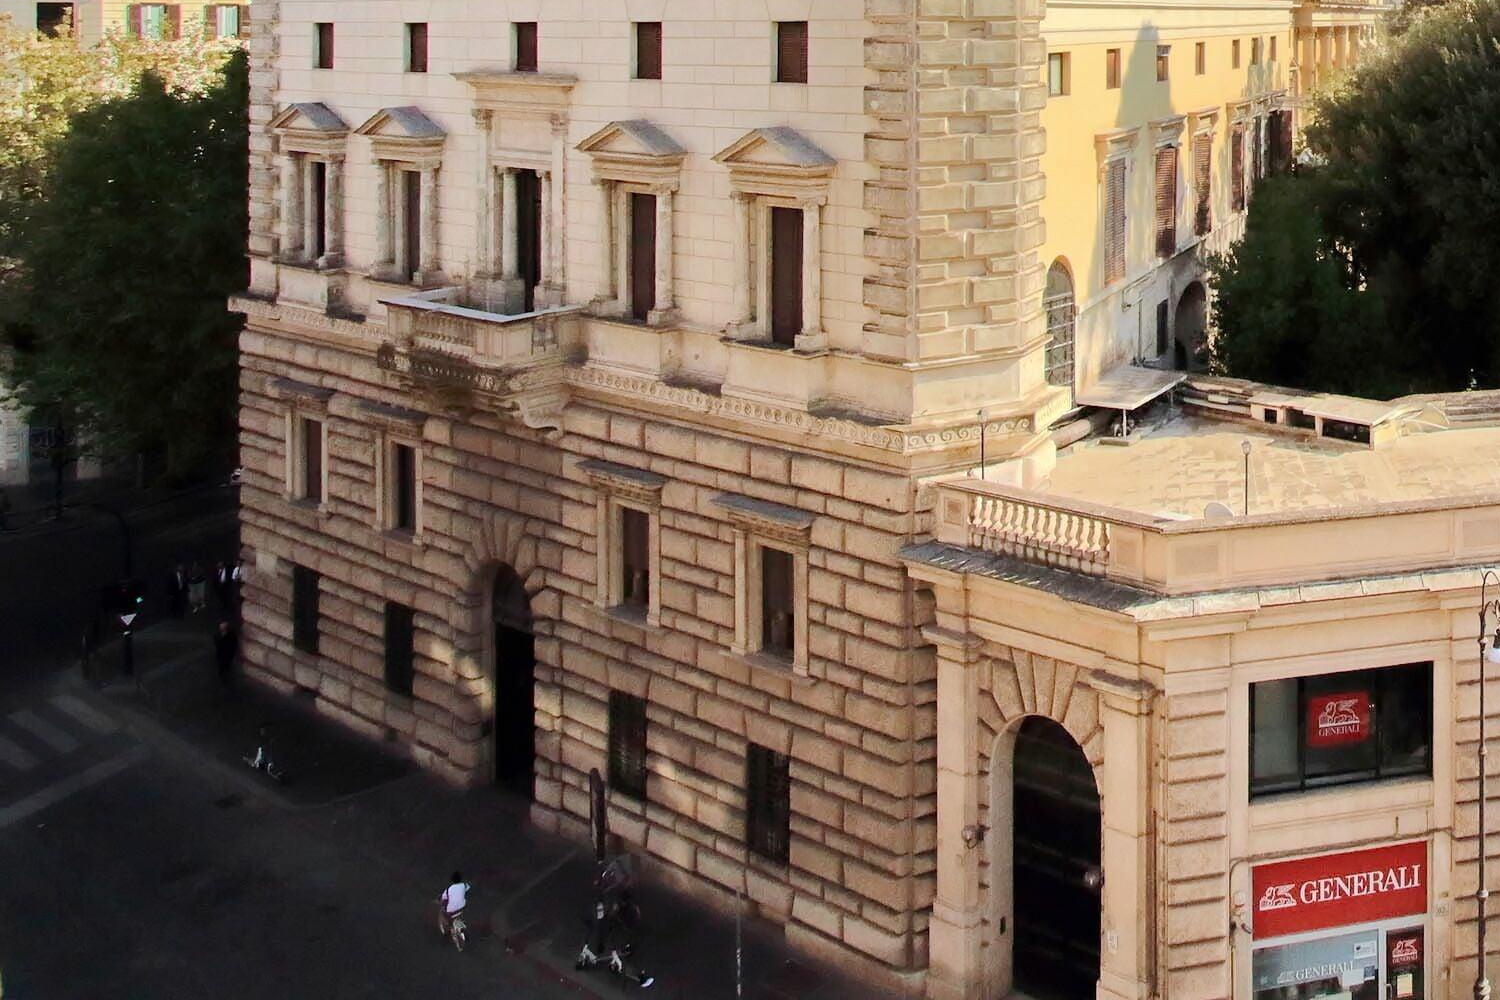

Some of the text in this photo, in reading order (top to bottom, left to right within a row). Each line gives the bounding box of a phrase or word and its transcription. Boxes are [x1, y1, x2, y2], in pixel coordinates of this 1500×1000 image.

[1318, 724, 1360, 736] GENERALI
[1299, 864, 1421, 904] GENERALI
[1295, 960, 1354, 981] GENERALI
